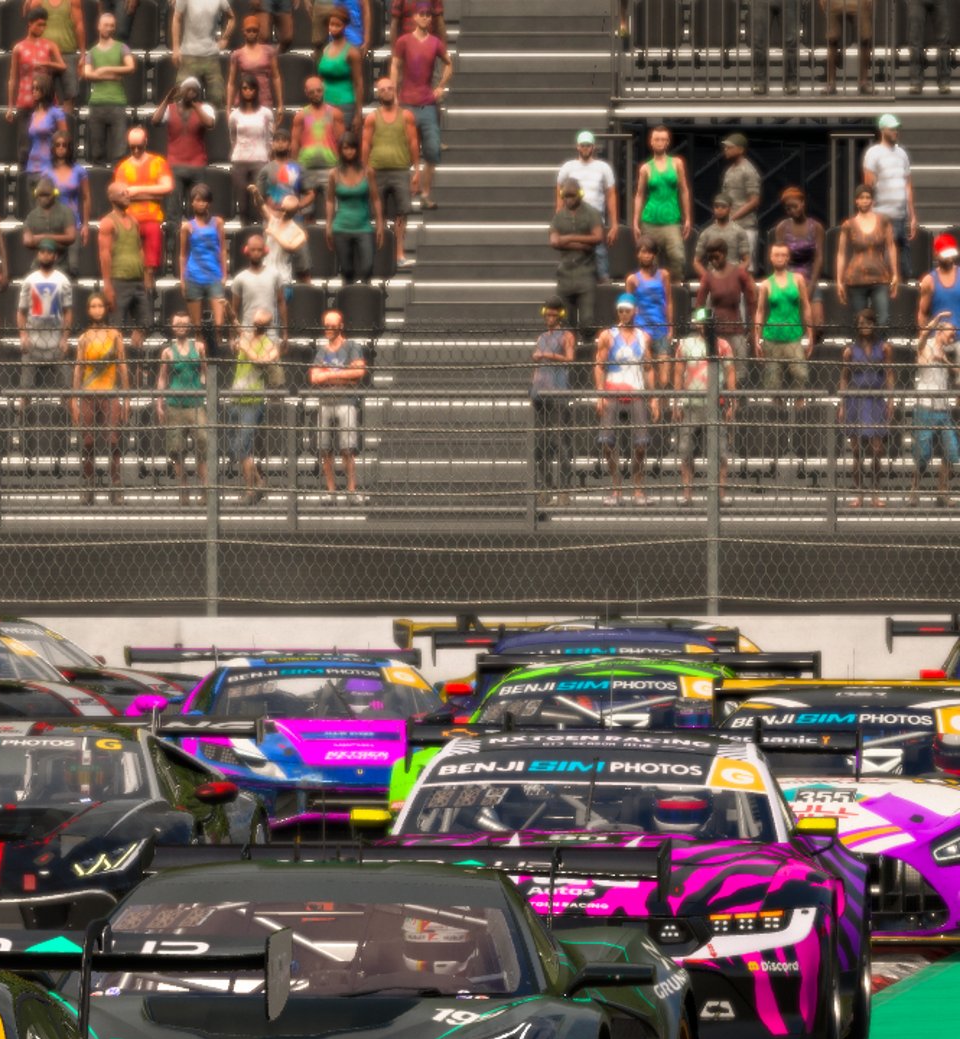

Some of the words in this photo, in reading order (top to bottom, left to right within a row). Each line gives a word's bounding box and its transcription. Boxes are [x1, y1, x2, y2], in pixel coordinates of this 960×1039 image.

[228, 670, 279, 683] BENJI
[326, 668, 381, 678] PHOTOS
[498, 681, 556, 697] BENJI
[556, 680, 611, 691] SIM
[612, 680, 678, 691] PHOTOS
[795, 712, 856, 724] SIM
[858, 713, 933, 725] PHOTOS
[1, 739, 76, 748] PHOTOS
[95, 738, 124, 751] G
[489, 735, 602, 744] NXTGEN
[606, 735, 711, 748] RACING
[437, 761, 525, 776] BENJI
[527, 760, 606, 773] SIM
[609, 761, 703, 777] PHOTOS
[720, 767, 756, 785] G
[797, 790, 852, 803] 355
[526, 886, 597, 897] Autos
[561, 901, 610, 910] RACING
[760, 960, 800, 973] Discord
